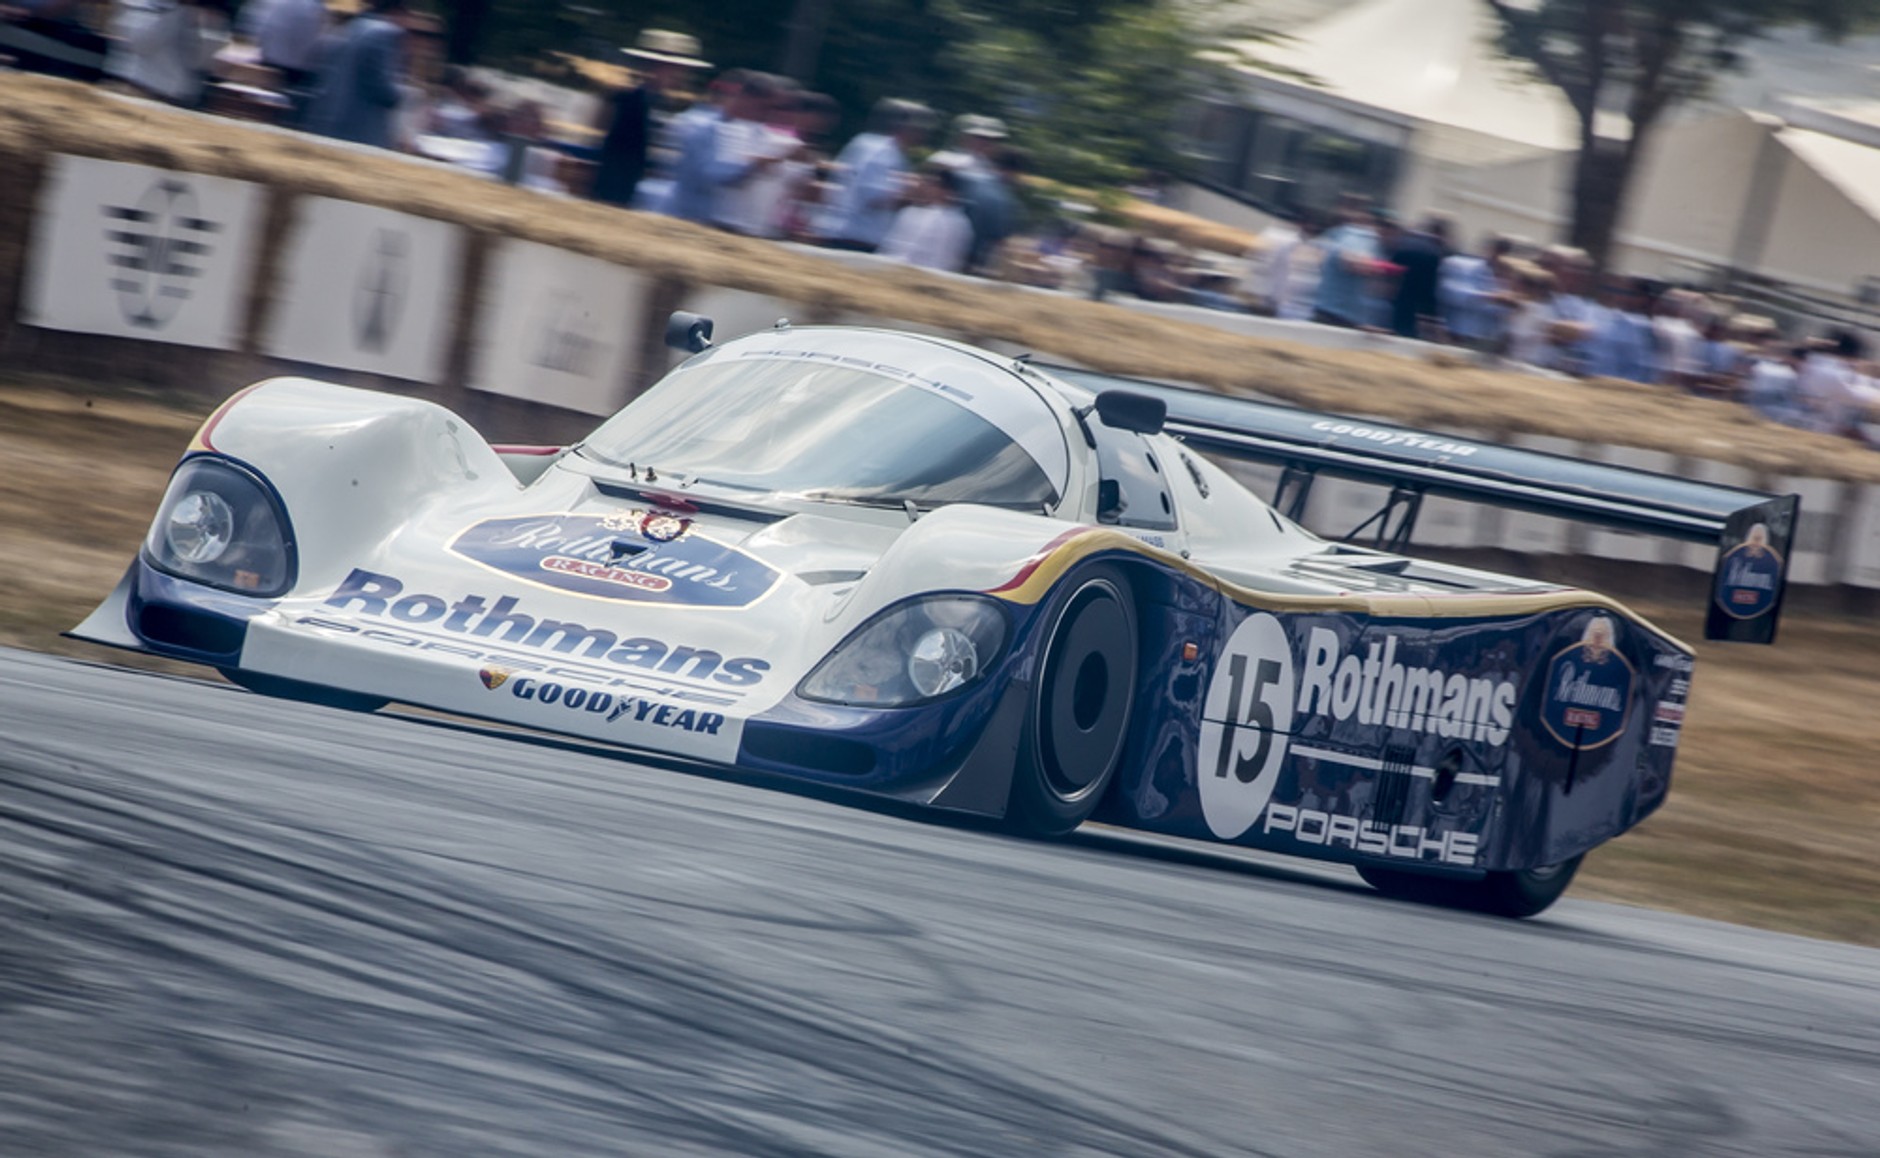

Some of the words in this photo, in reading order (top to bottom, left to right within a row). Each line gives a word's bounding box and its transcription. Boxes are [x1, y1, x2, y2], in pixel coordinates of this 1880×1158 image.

[741, 350, 974, 401] PORSCHE
[1311, 420, 1478, 457] GOODYEAR
[551, 558, 658, 588] RACING
[323, 567, 772, 687] Rothmans
[295, 616, 740, 706] PORSCHE
[1297, 626, 1517, 746] Rothmans
[512, 678, 725, 735] GOODYEAR
[1215, 653, 1282, 783] 15
[1263, 802, 1479, 865] PORSCHE
